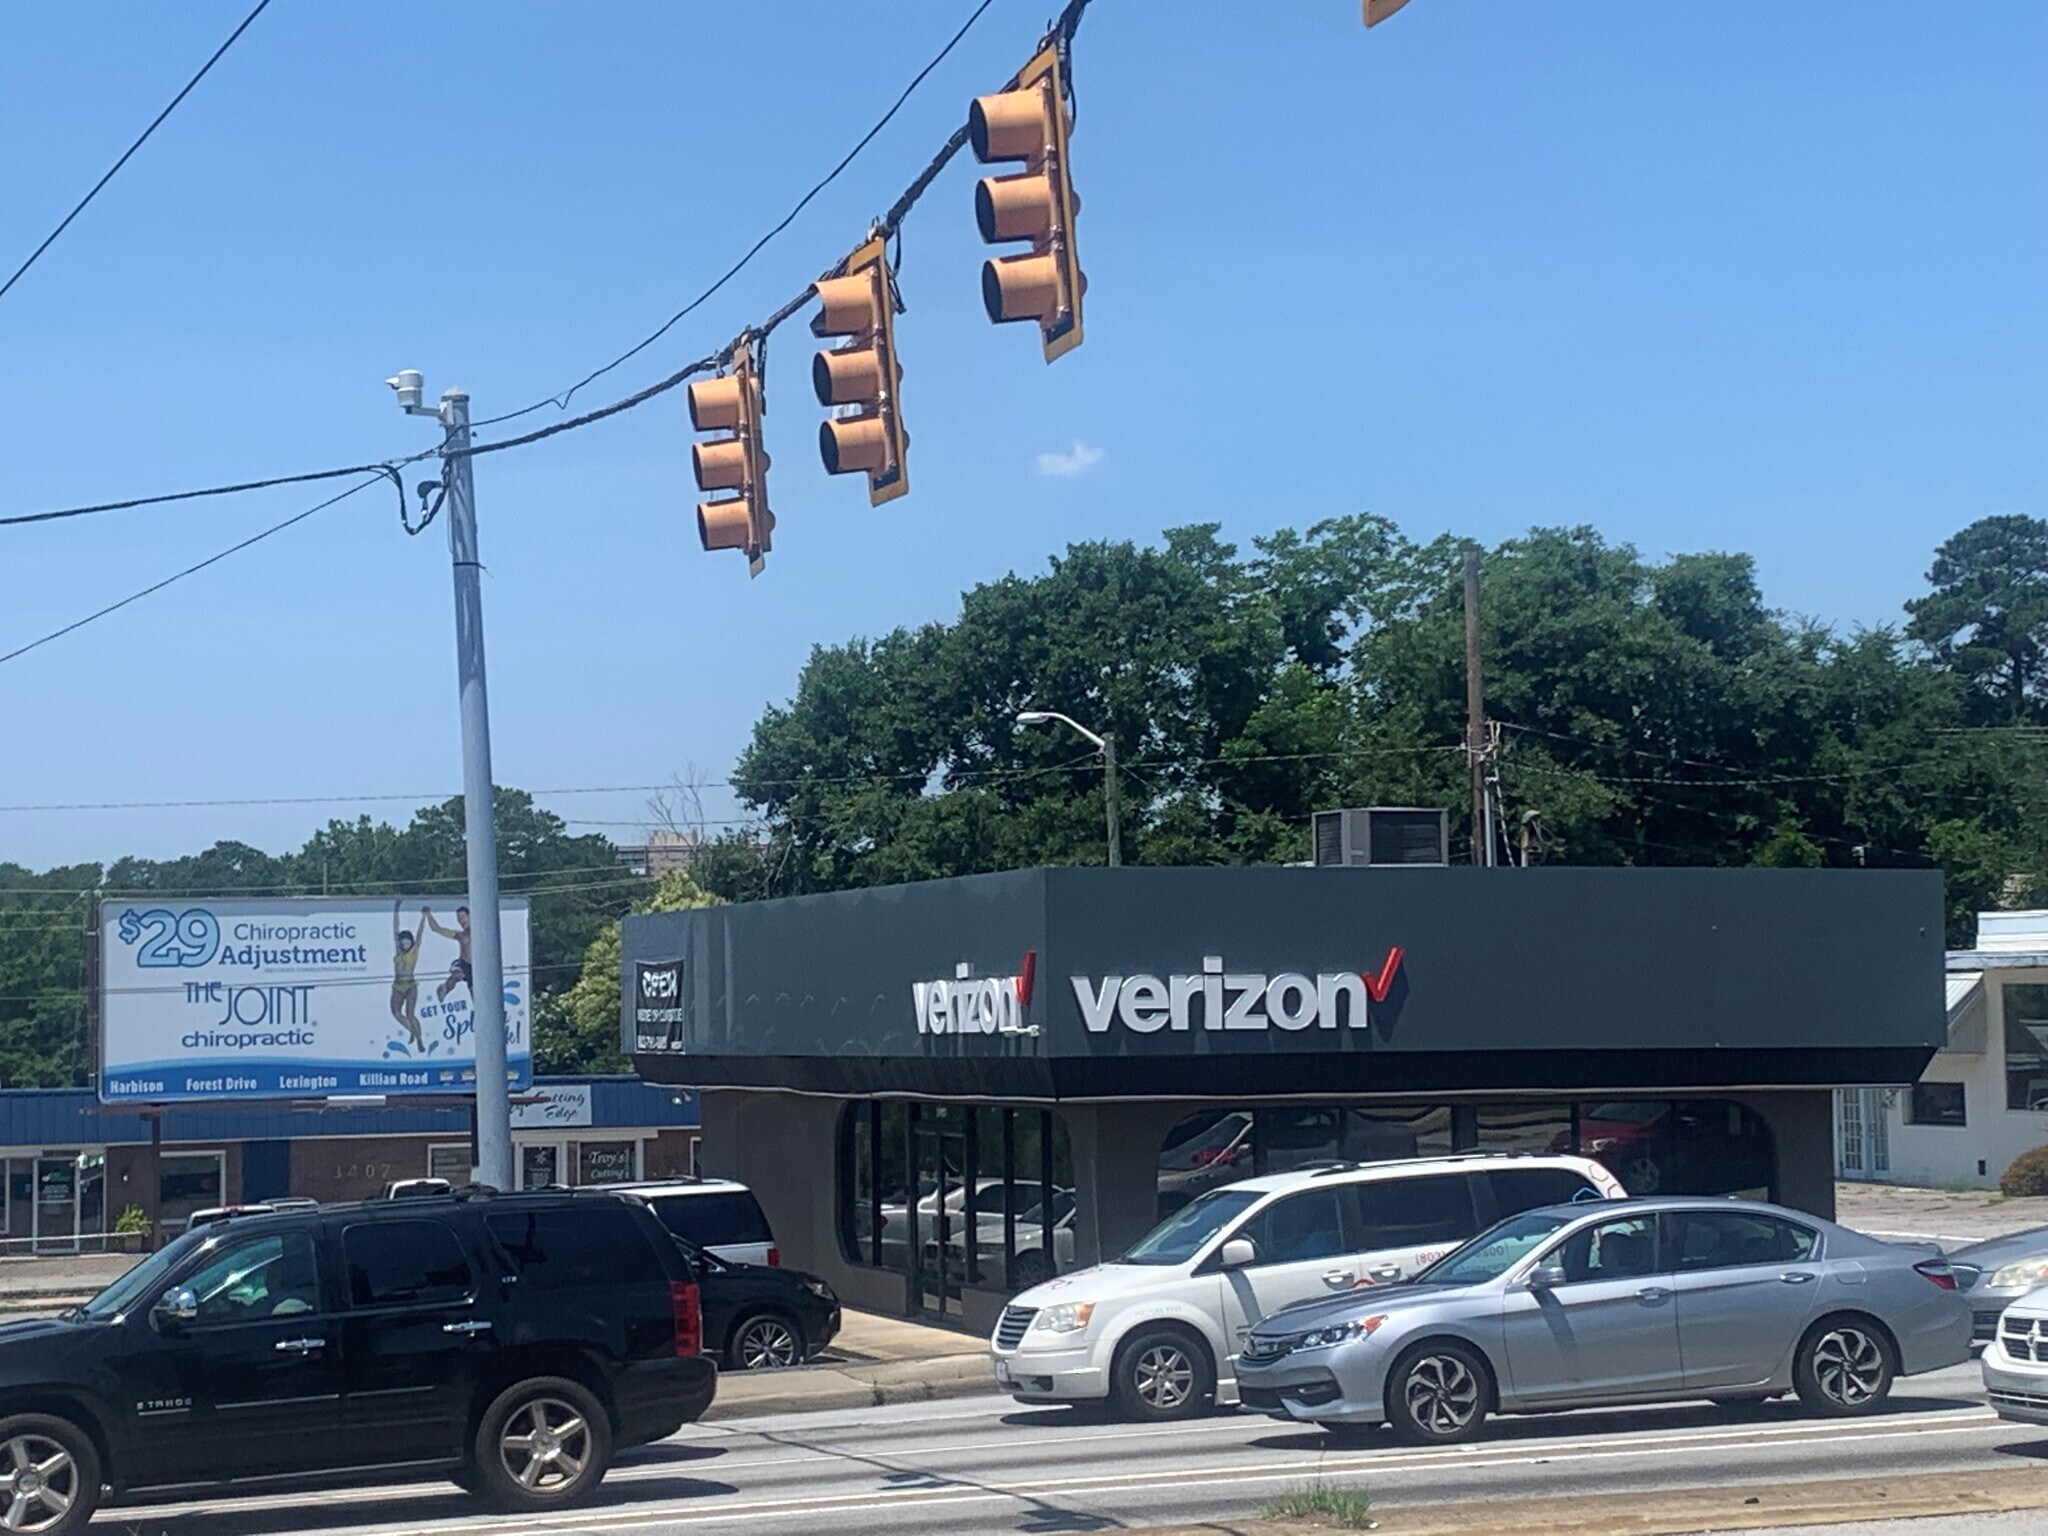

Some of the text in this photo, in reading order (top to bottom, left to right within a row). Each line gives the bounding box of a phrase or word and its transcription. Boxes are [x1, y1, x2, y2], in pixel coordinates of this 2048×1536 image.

[118, 908, 221, 968] $29
[233, 922, 357, 943] Chiropractic
[218, 944, 367, 970] Adjustment
[182, 981, 222, 1003] THE
[912, 962, 1023, 1034] verizon
[1071, 956, 1368, 1033] verizon
[218, 985, 315, 1025] JOINT
[420, 1000, 467, 1018] GET YOUR
[181, 1028, 315, 1049] chiropractic
[110, 1080, 164, 1094] Harbison
[186, 1076, 257, 1091] Forest Drive
[279, 1075, 338, 1090] Lexington
[359, 1071, 429, 1086] Killian Road
[544, 1105, 578, 1122] Edge
